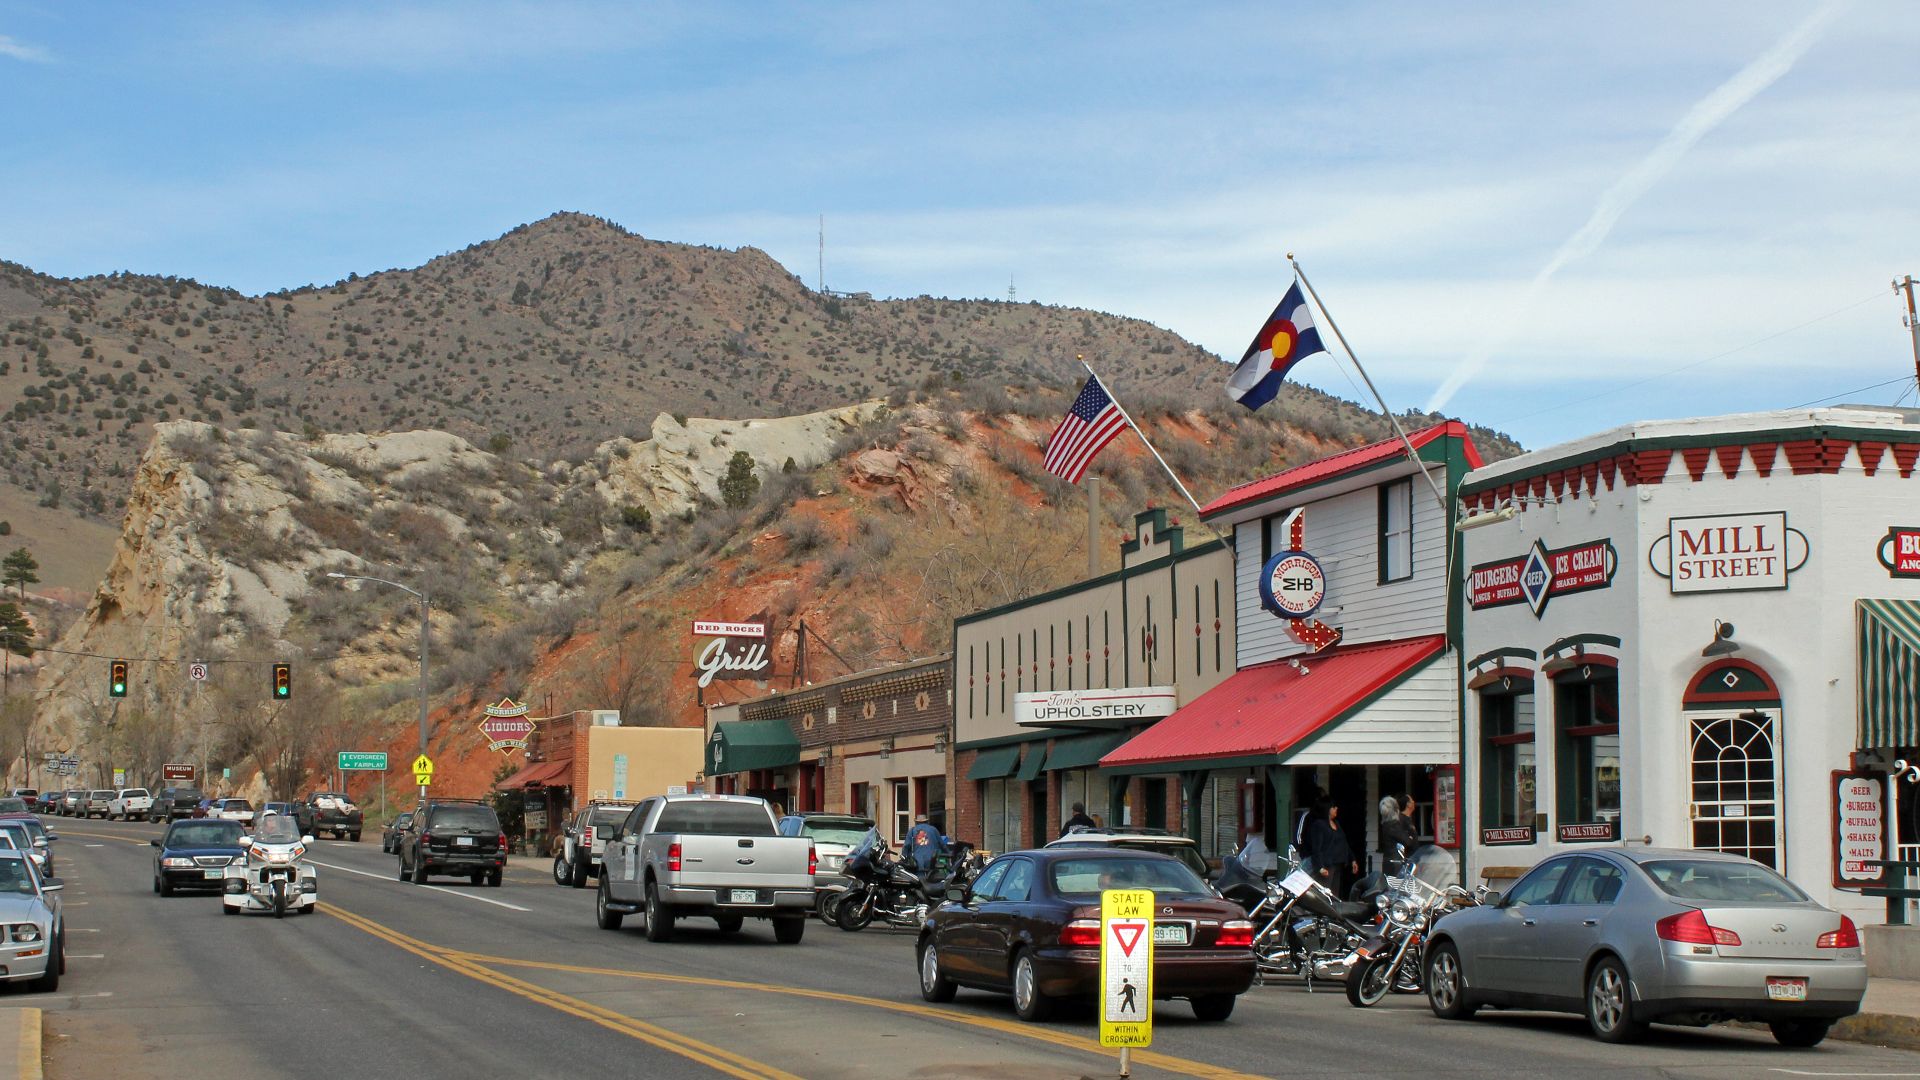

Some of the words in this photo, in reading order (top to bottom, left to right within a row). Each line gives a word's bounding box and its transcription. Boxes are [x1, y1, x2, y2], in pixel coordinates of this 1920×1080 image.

[1678, 525, 1775, 556] MILL
[1556, 554, 1568, 575] ICE
[1573, 547, 1603, 571] CREAM
[1273, 558, 1321, 579] MORRISON
[1679, 557, 1776, 580] STREET
[1474, 564, 1519, 590] BURGERS
[1527, 570, 1544, 587] BEER
[1556, 576, 1578, 589] SHAKES
[1584, 571, 1603, 583] MALTS
[1474, 591, 1491, 603] ANGUS
[1497, 586, 1520, 599] BUFFALO
[1273, 590, 1304, 611] HOLIDAY
[1308, 591, 1323, 607] BAR
[725, 625, 762, 633] ROCKS
[698, 637, 769, 688] Grill
[1047, 693, 1082, 706] Tom's
[486, 705, 528, 715] MORRISON
[1034, 703, 1146, 719] UPHOLSTERY
[484, 722, 531, 732] LIQUORS
[1852, 786, 1871, 796] BEER
[1848, 801, 1876, 811] BURGERS
[1848, 818, 1877, 827] BUFFALO
[1489, 830, 1503, 840] MILL
[1504, 829, 1525, 839] STREET
[1567, 826, 1581, 836] MILL
[1583, 825, 1605, 836] STREET
[1849, 833, 1876, 842] SHAKES
[1851, 848, 1874, 857] MALTS
[1112, 894, 1145, 904] STATE
[1117, 906, 1139, 916] LAW
[1123, 964, 1132, 972] TO
[1114, 1025, 1139, 1033] WITHIN
[1105, 1034, 1147, 1043] CROSSWALK
